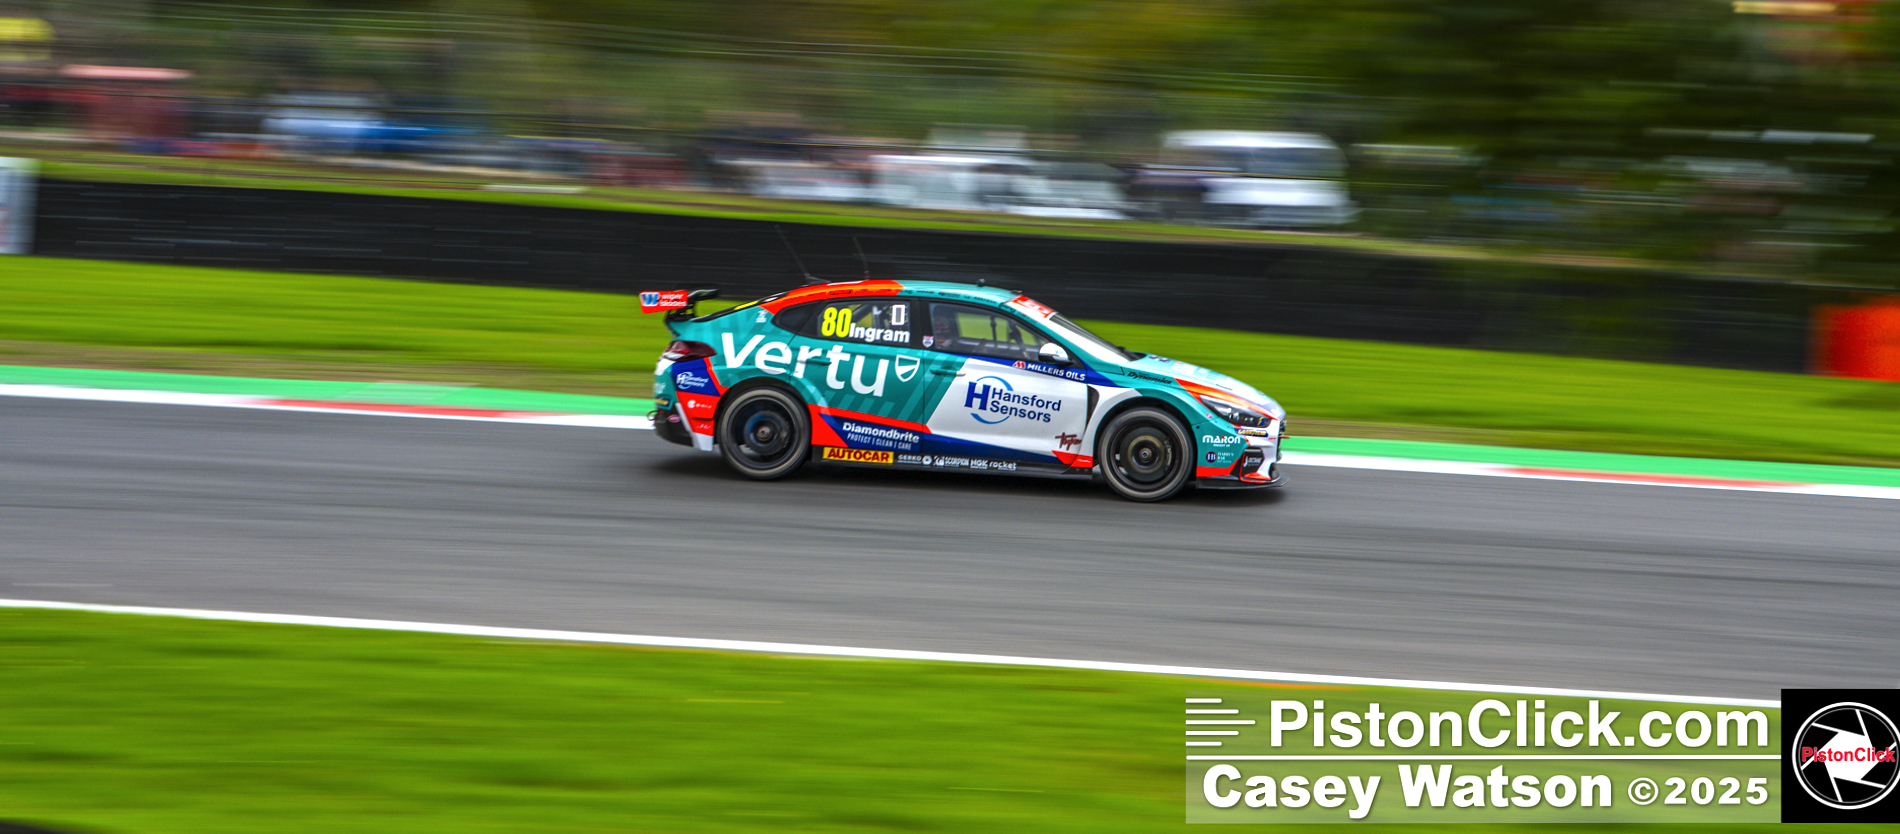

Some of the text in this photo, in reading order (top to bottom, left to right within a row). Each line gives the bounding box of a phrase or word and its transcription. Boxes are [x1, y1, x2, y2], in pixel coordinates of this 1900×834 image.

[821, 306, 852, 338] 80
[848, 322, 910, 343] Ingram
[1027, 363, 1086, 381] MILLERS OILS
[1127, 371, 1173, 385] Dynamics
[991, 387, 1062, 412] Hansford
[989, 400, 1052, 423] Sensors
[842, 421, 920, 444] Diamondbrite
[847, 432, 912, 451] PROTECT CLEAN CARE
[827, 448, 890, 463] AUTOCAR
[989, 460, 1017, 469] rocket
